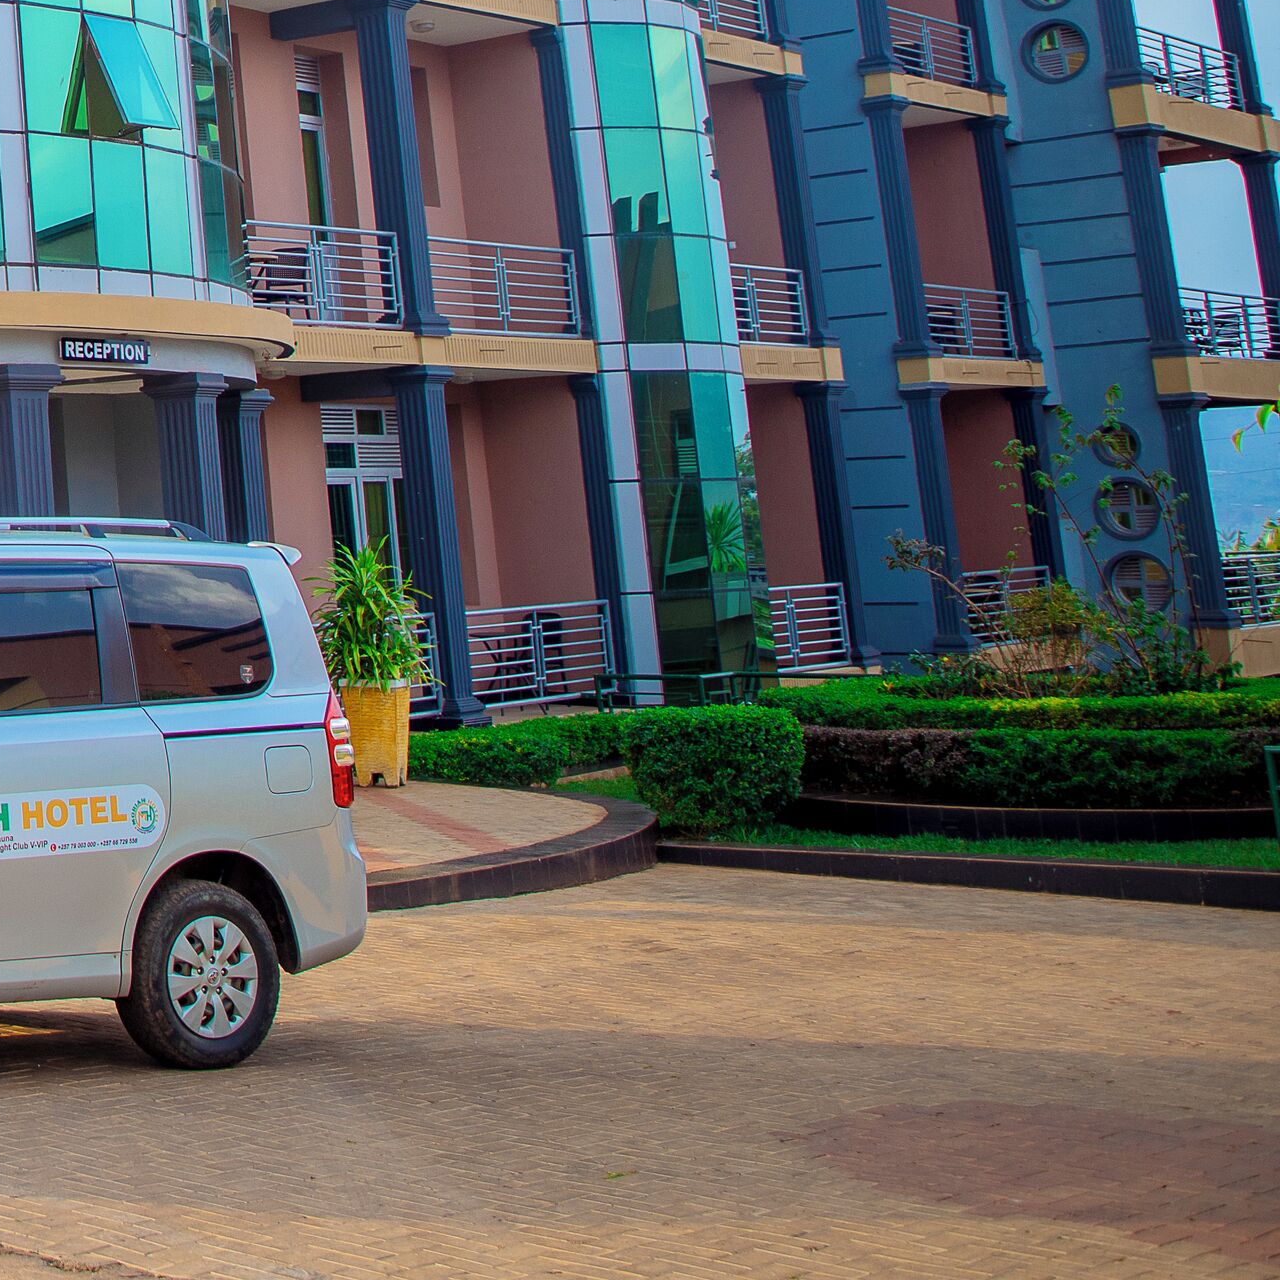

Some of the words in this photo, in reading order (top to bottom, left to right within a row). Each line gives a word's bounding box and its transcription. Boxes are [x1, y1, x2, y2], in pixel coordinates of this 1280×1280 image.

[65, 340, 145, 361] RECEPTION
[21, 795, 128, 830] HOTEL
[12, 841, 29, 851] Club
[29, 840, 48, 849] V-VIP
